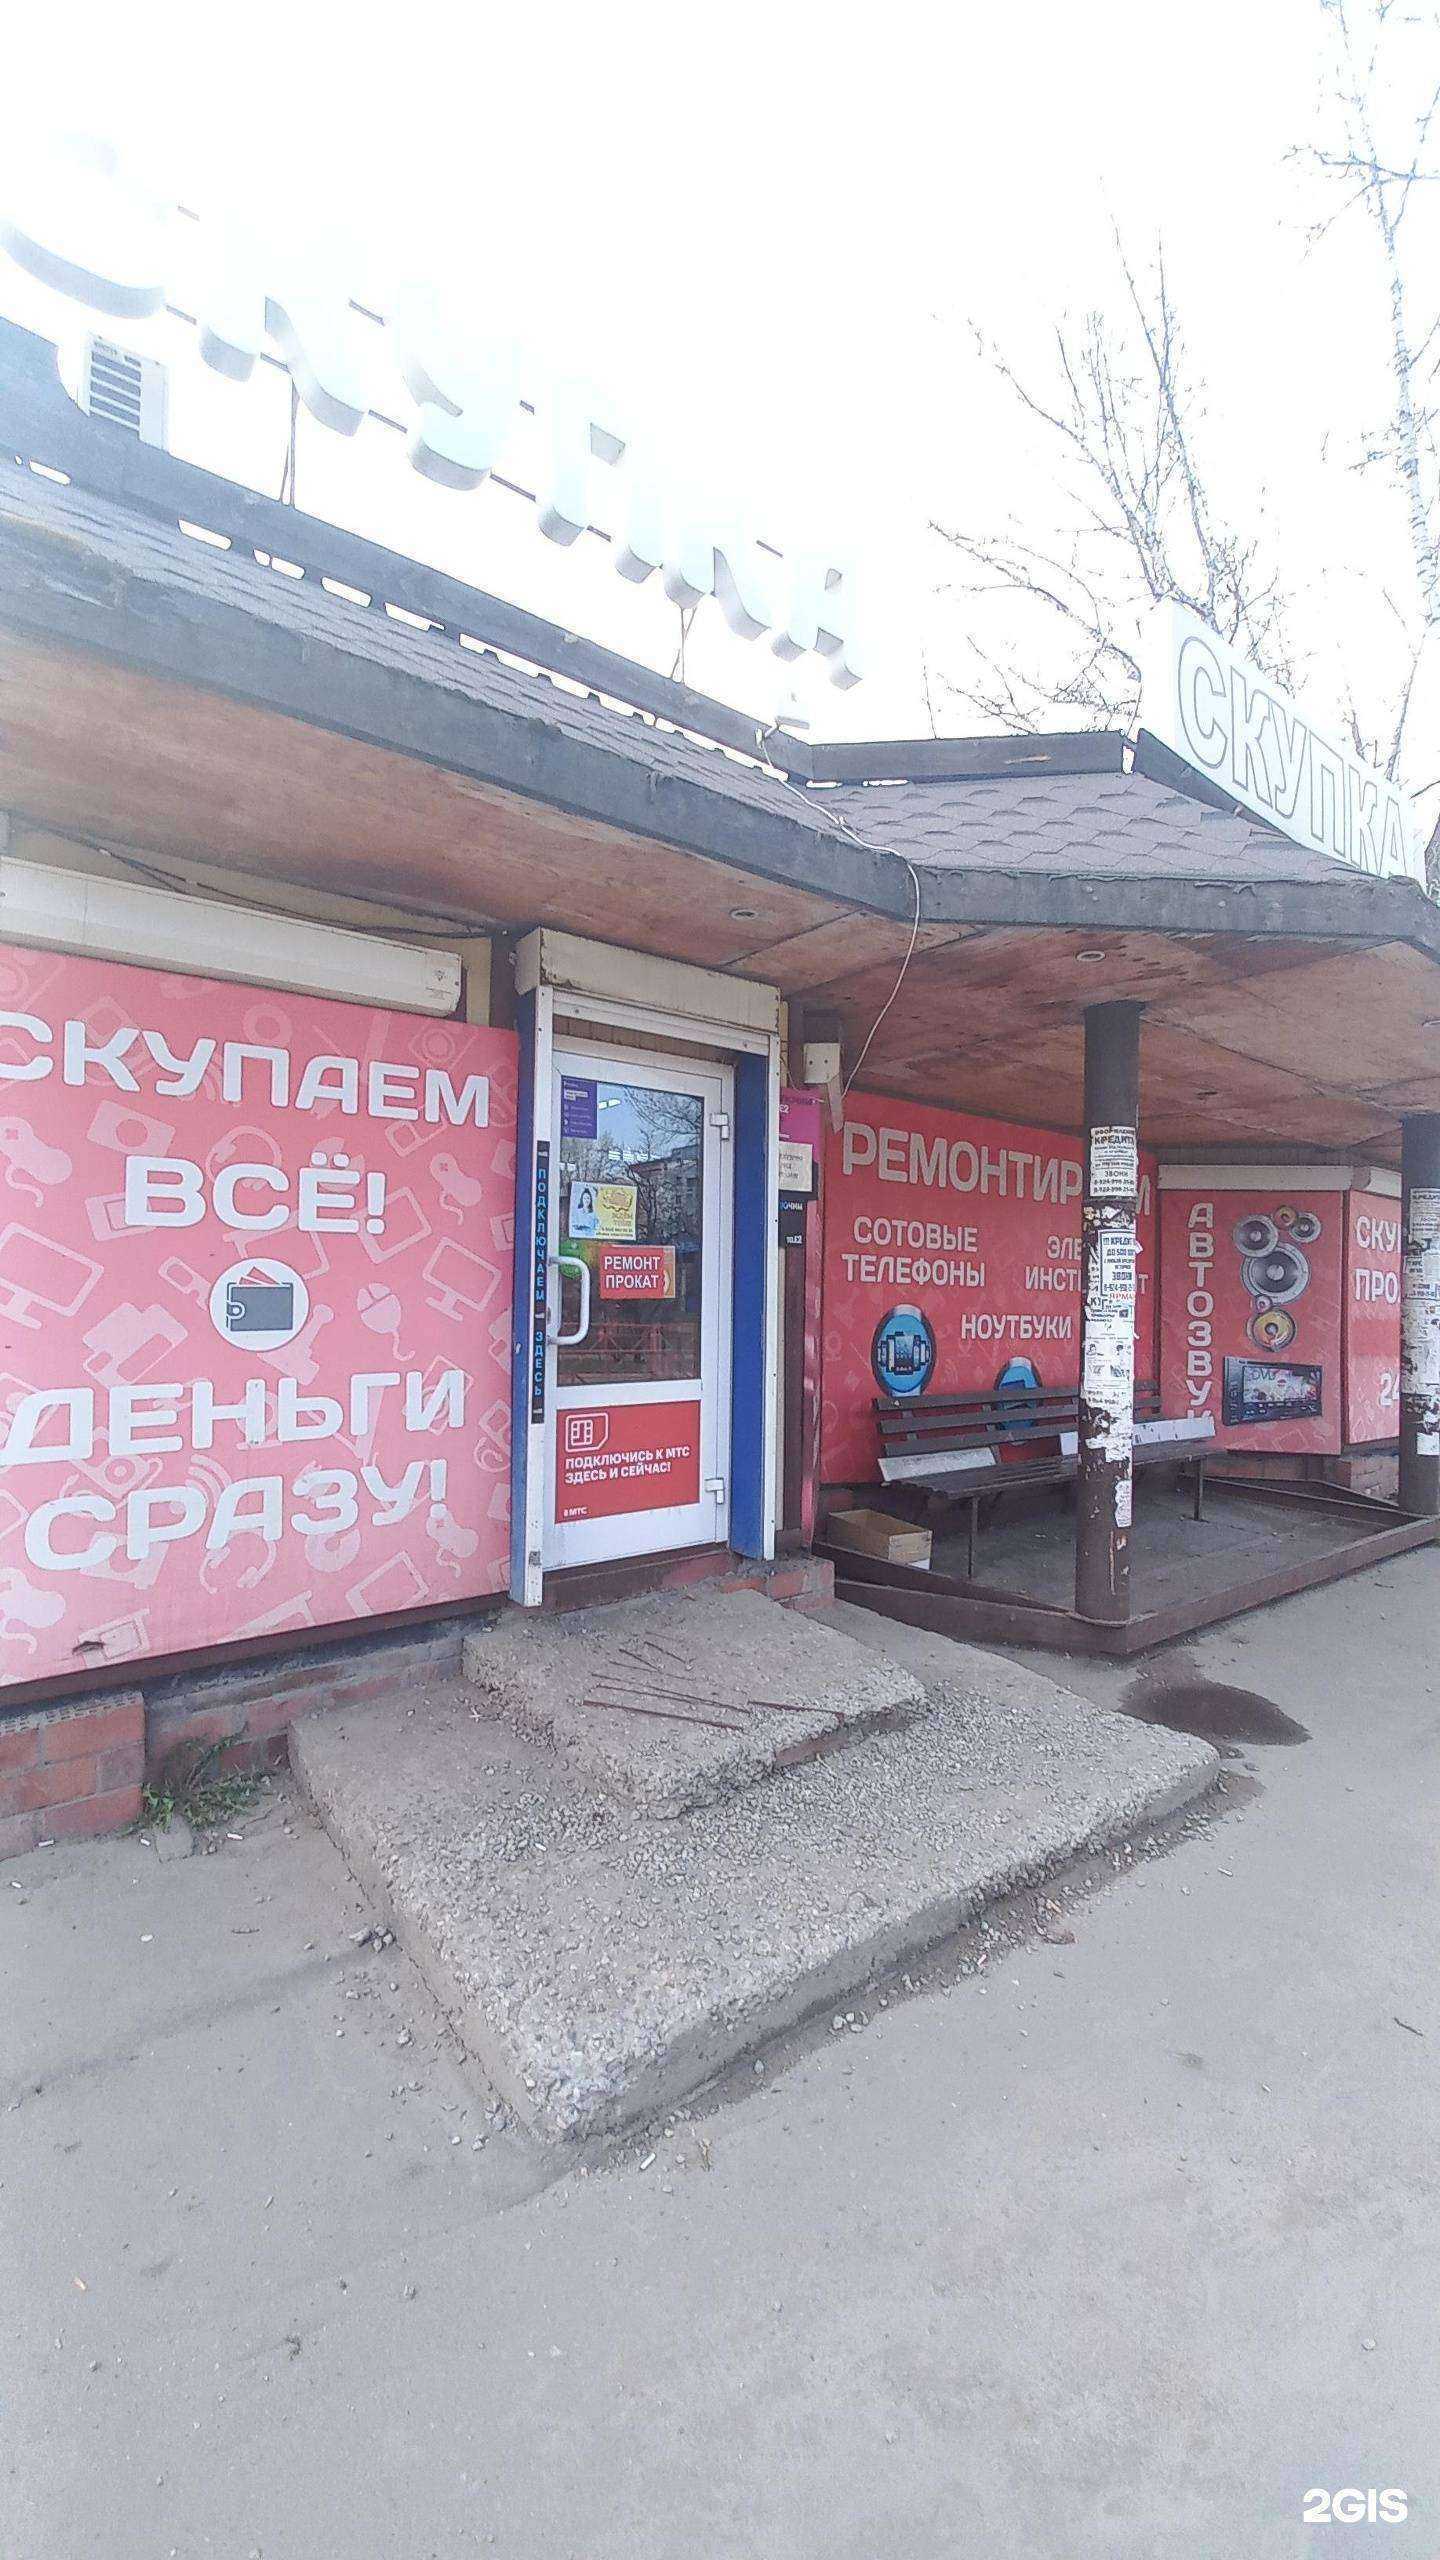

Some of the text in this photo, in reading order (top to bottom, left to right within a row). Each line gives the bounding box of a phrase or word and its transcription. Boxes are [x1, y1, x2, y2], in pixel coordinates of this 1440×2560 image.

[1177, 635, 1407, 876] СКУПКА
[0, 1011, 490, 1128] СКУПАЕМ
[124, 1151, 388, 1235] ВСЁ!
[853, 1215, 979, 1253] СОТОВЫЕ
[1355, 1215, 1401, 1252] СКУ
[604, 1255, 661, 1270] РЕМОНТ
[605, 1274, 660, 1289] ПРОКАТ
[841, 1252, 986, 1288] ТЕЛЕФОНЫ
[533, 1168, 548, 1397] ПОДКЛЮЧАЕМ ЗДЕСЬ
[1355, 1267, 1401, 1305] ПРО
[961, 1313, 1073, 1341] НОУТБУКИ
[0, 1370, 465, 1466] ДЕНЬГИ
[565, 1446, 690, 1470] ПОДКЛЮЧИСЬ К МТС
[565, 1461, 671, 1485] ЗДЕСЬ И СЕЙЧАС!
[24, 1459, 447, 1572] СРАЗУ!
